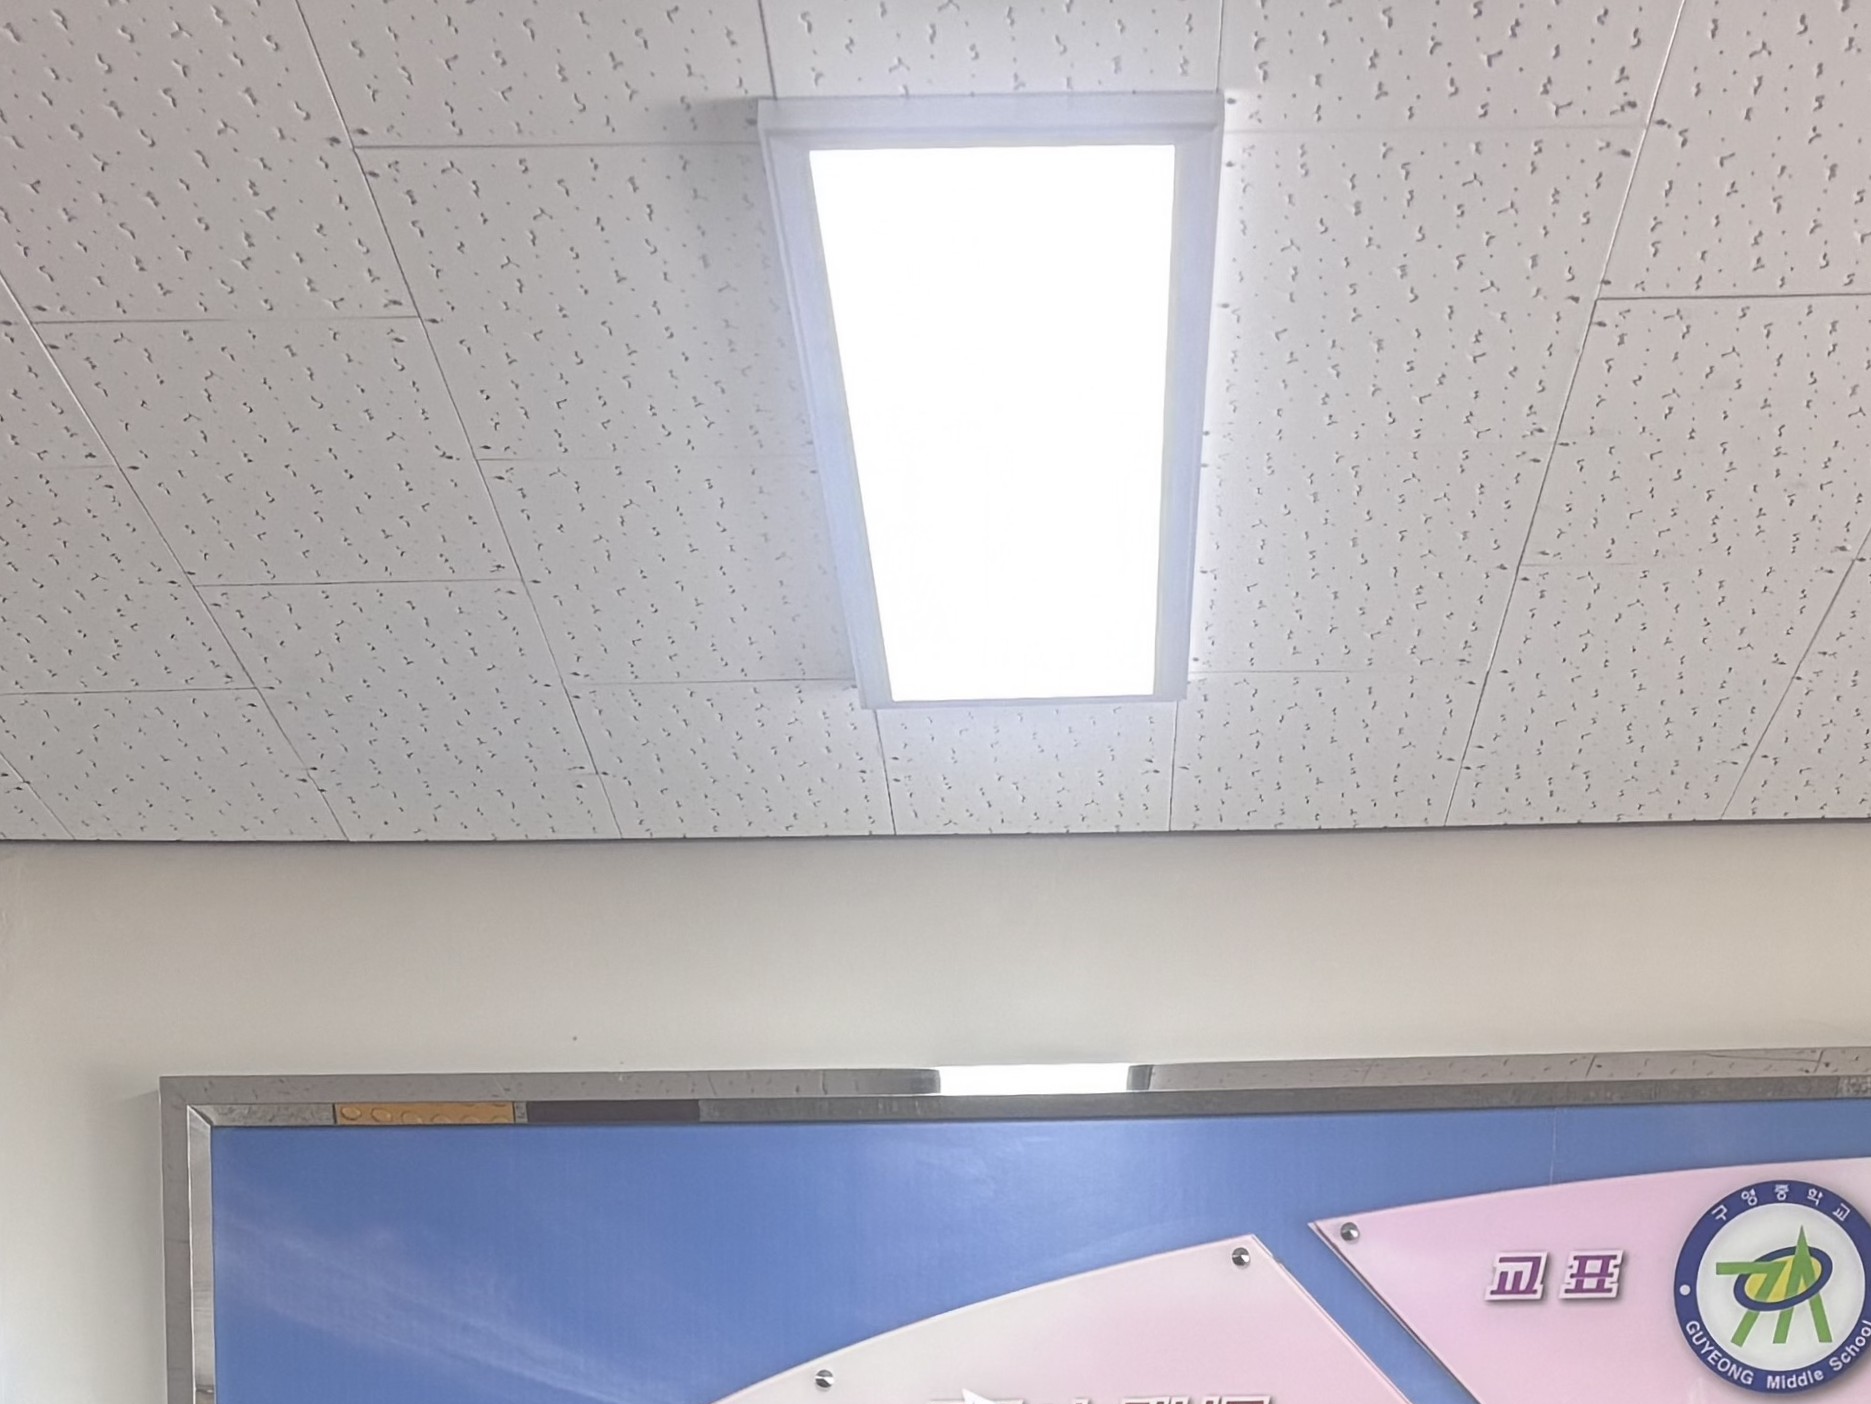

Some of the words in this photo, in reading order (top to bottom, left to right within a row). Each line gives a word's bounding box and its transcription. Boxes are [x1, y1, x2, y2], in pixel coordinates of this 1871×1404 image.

[1711, 1184, 1850, 1222] 구영중학교
[1685, 1320, 1754, 1386] GUYEONG
[1766, 1369, 1825, 1391] Middle
